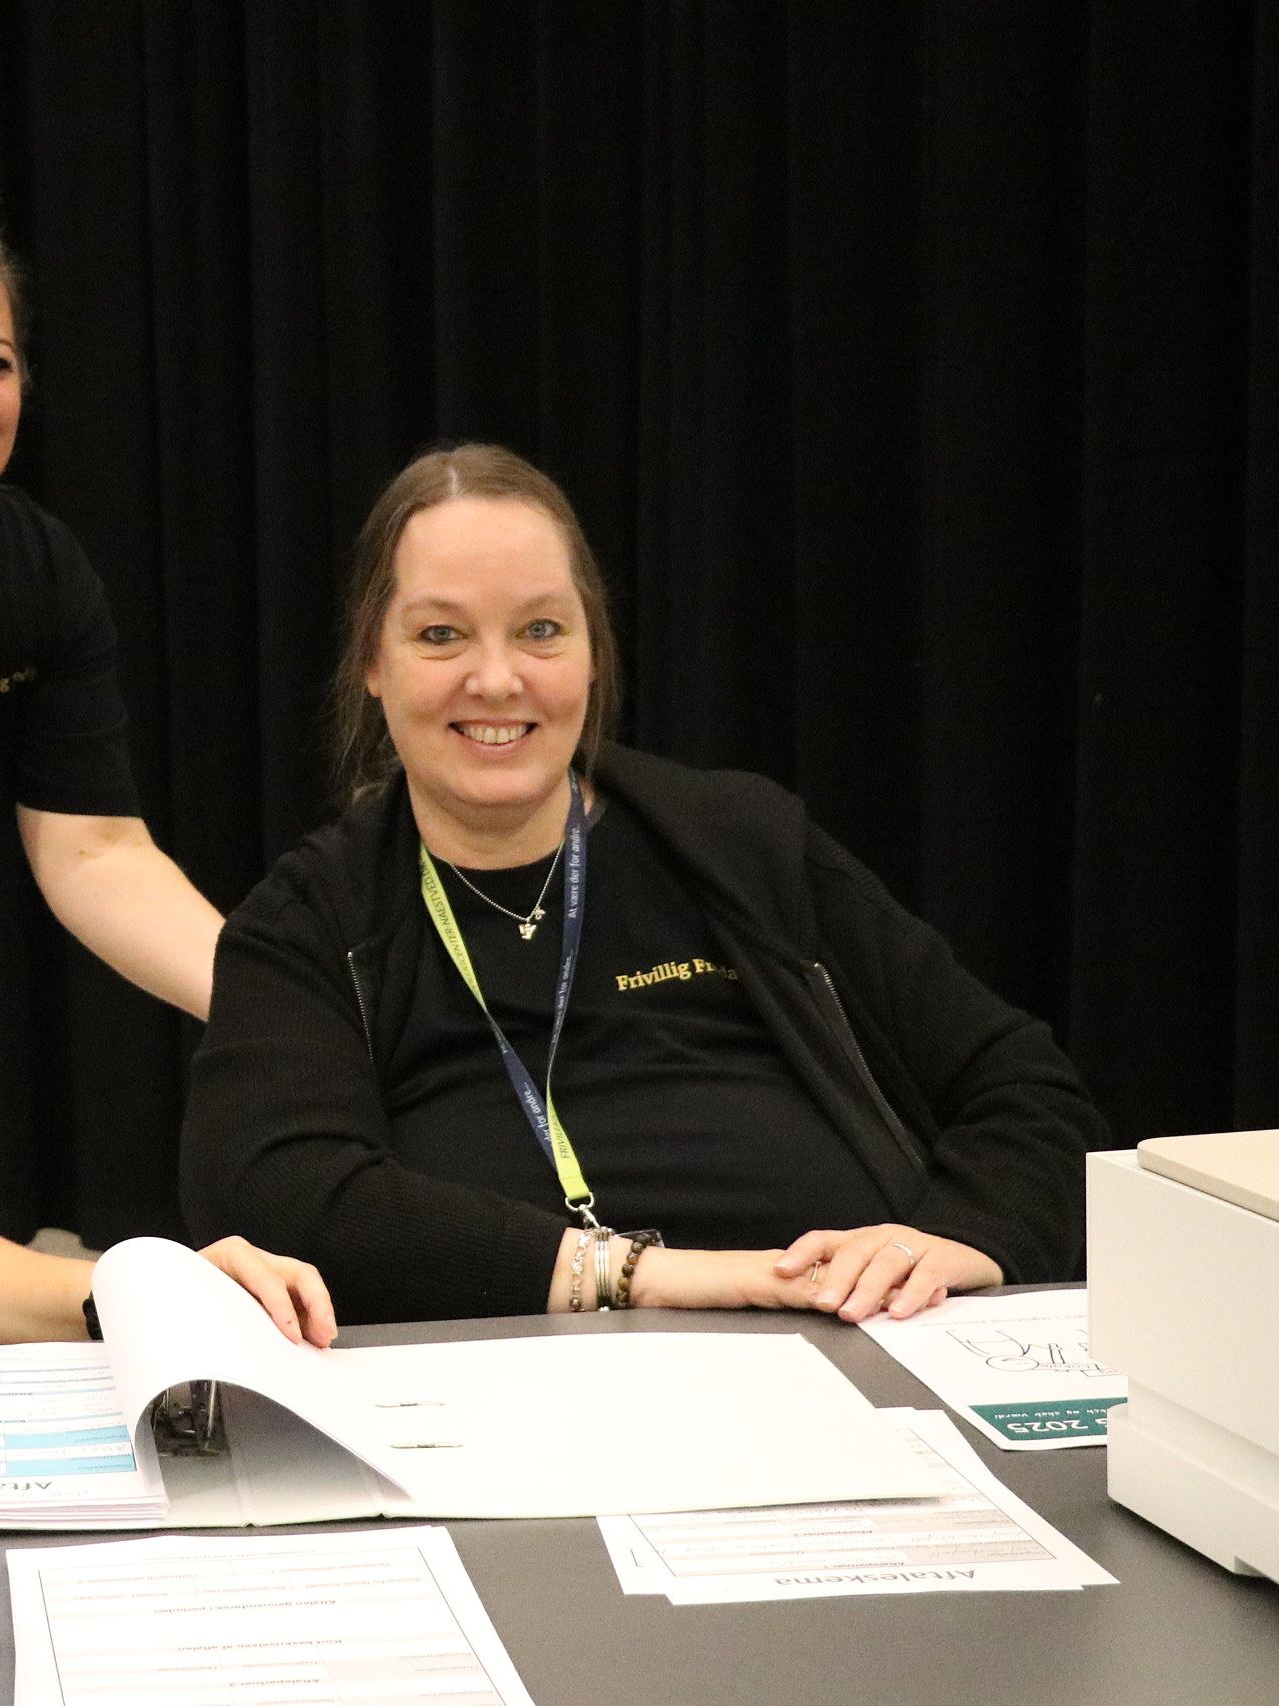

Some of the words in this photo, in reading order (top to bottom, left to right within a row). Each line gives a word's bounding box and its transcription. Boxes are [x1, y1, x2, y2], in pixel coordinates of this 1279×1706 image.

[615, 961, 691, 991] Frivillig
[1007, 1420, 1089, 1433] 2025
[774, 1570, 975, 1586] Aftaleskema
